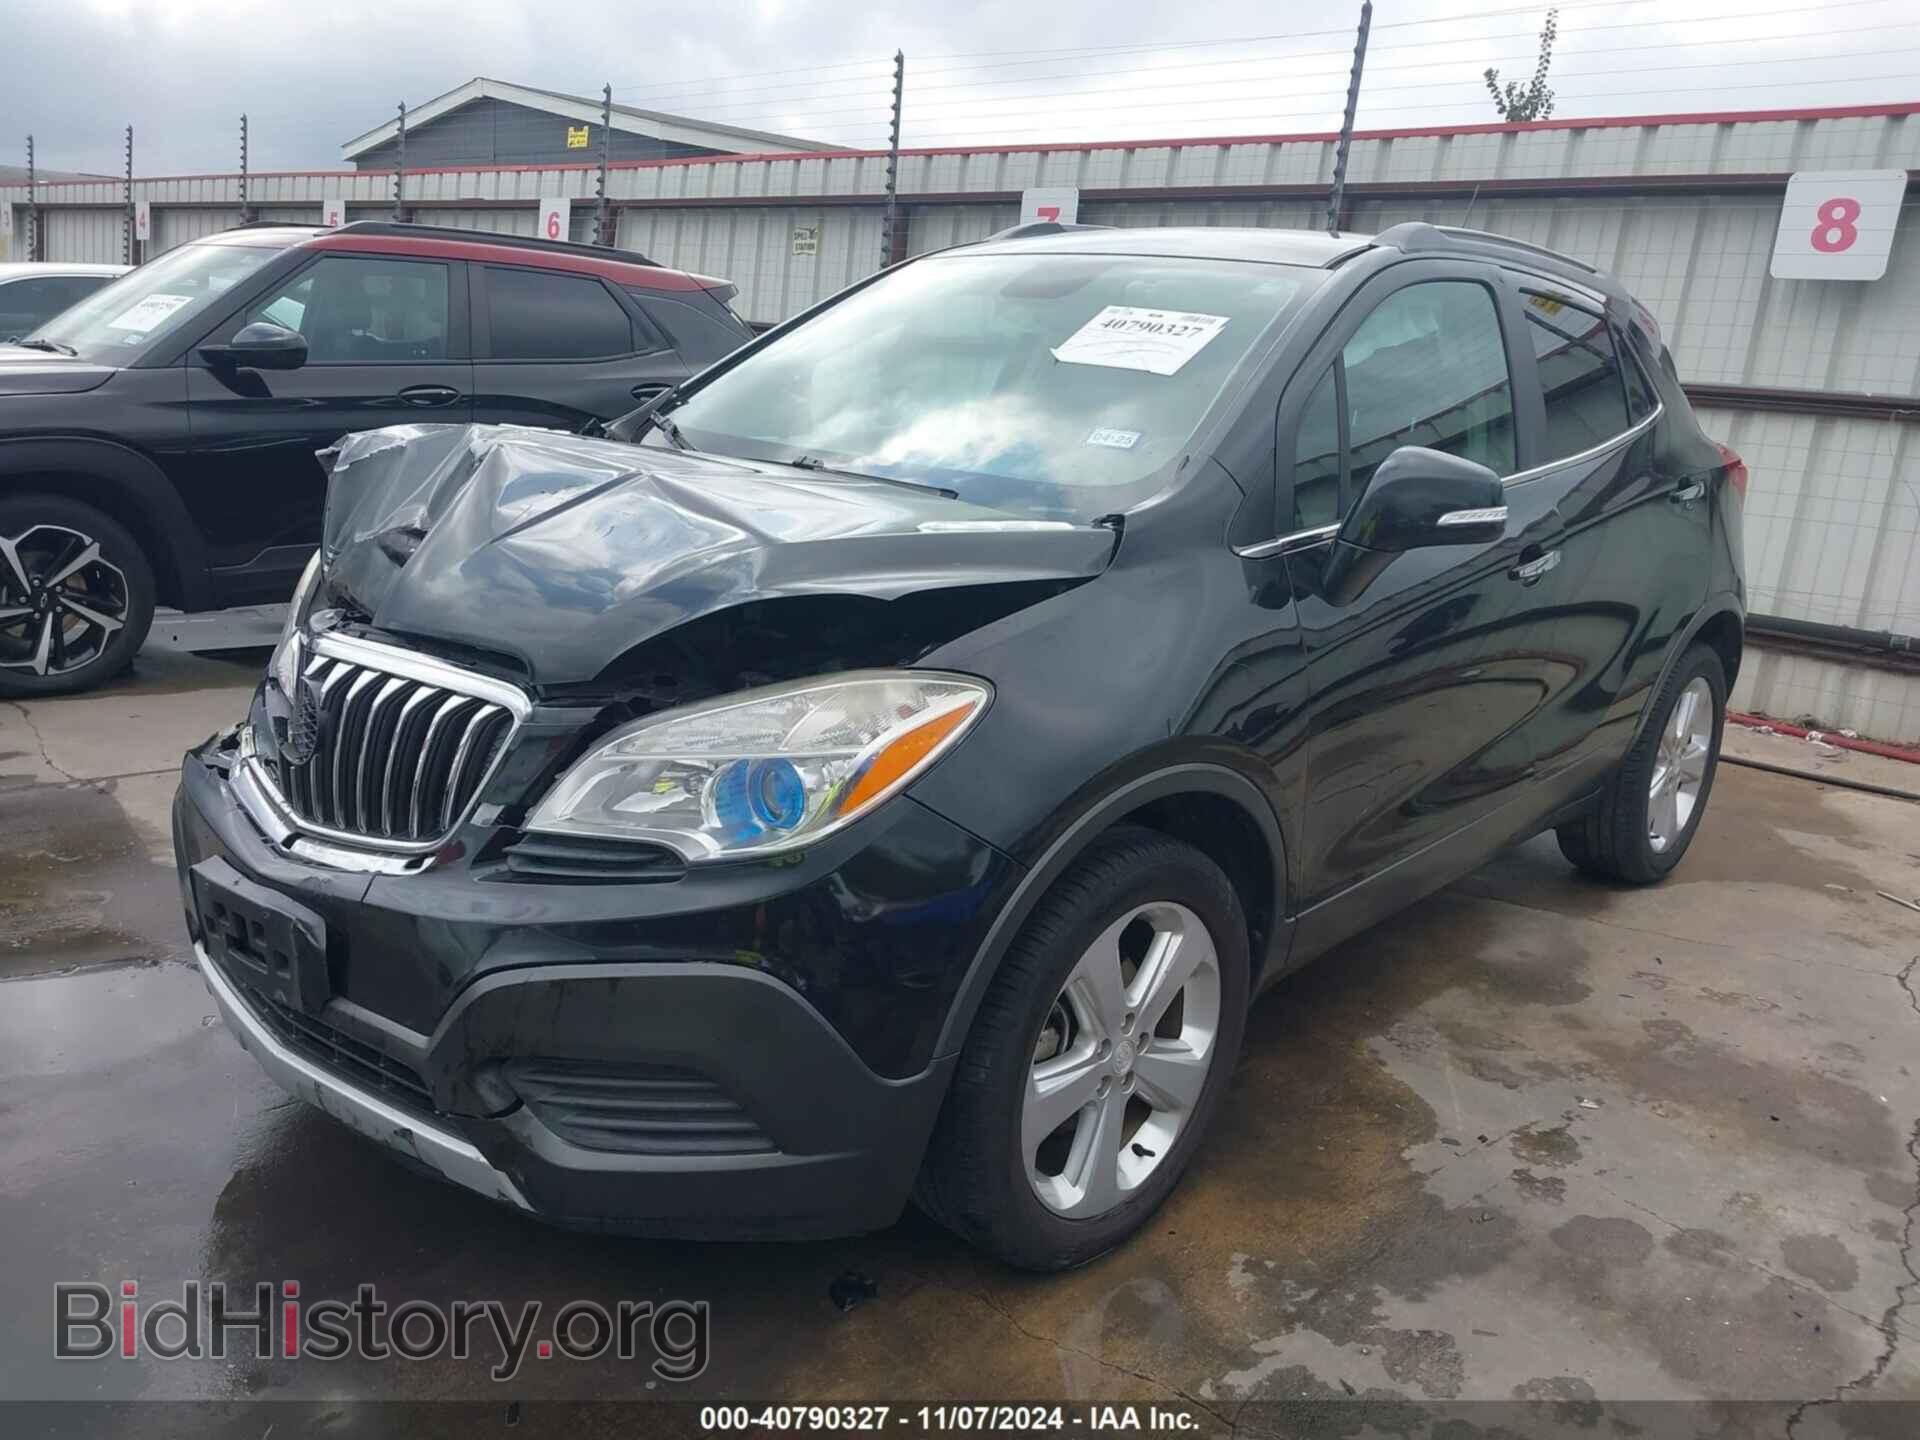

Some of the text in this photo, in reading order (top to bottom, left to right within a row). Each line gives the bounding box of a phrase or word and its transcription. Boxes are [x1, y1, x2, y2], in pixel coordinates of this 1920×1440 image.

[547, 211, 560, 240] 6
[1810, 197, 1861, 253] 8
[1101, 318, 1203, 338] 40790327
